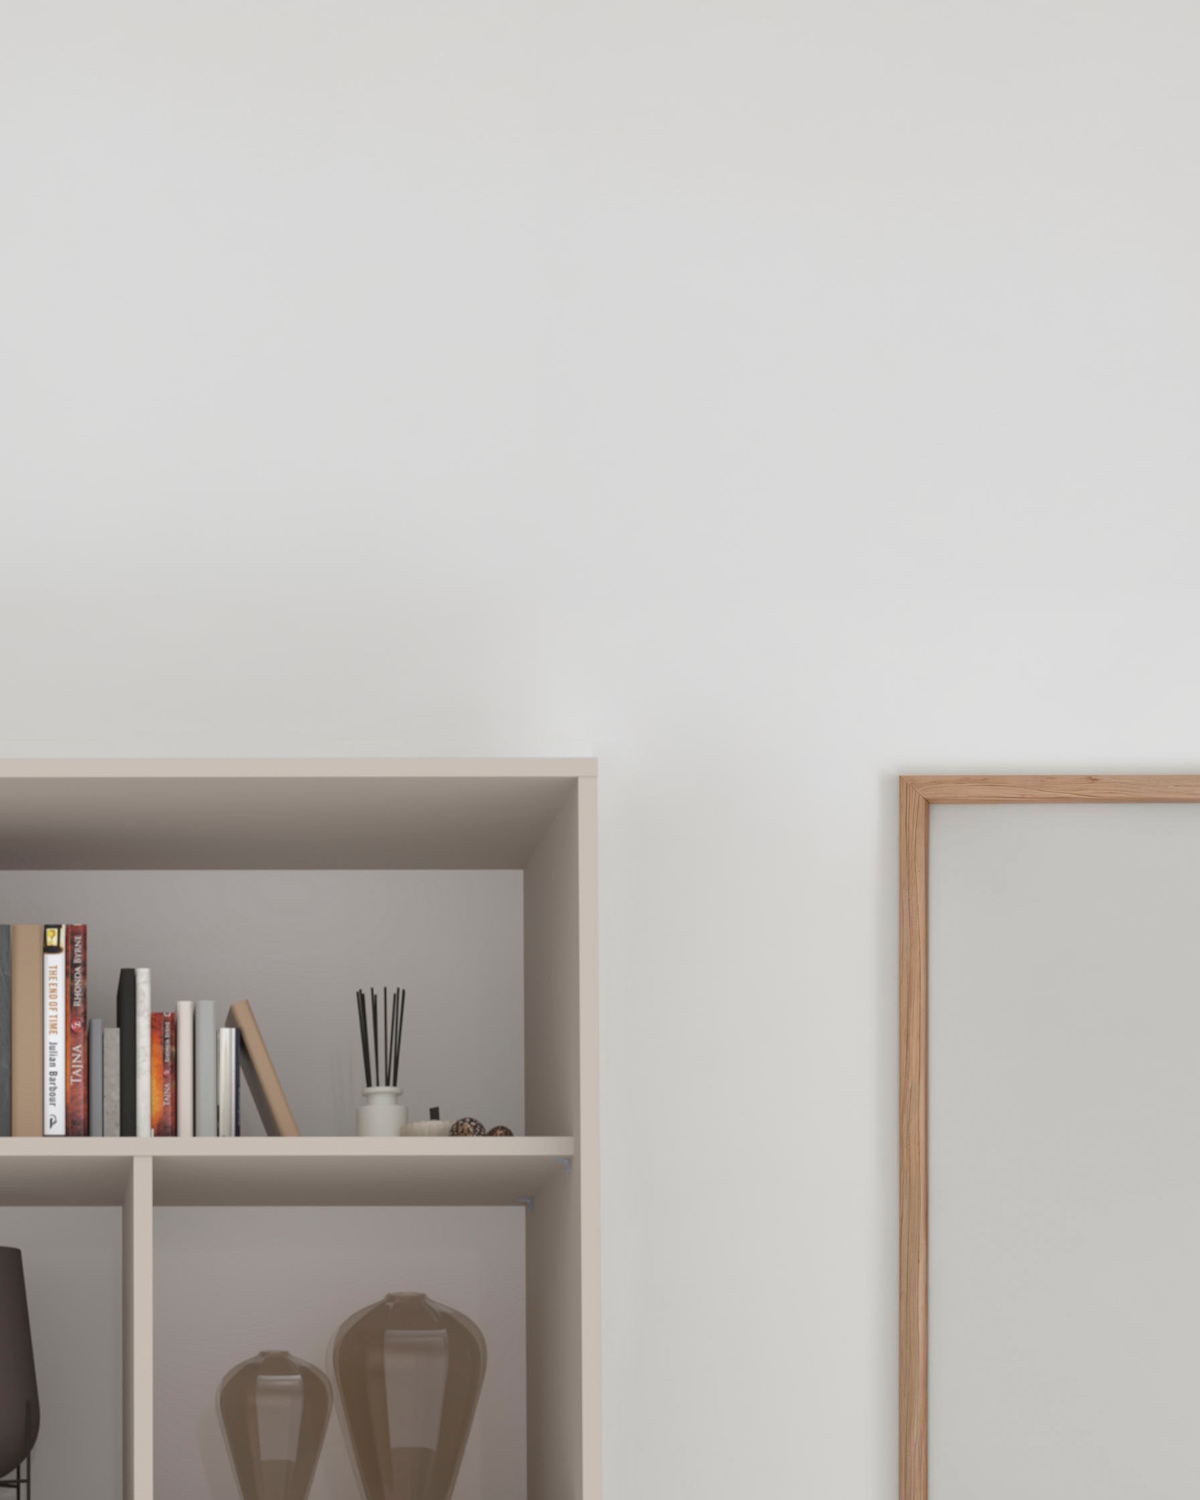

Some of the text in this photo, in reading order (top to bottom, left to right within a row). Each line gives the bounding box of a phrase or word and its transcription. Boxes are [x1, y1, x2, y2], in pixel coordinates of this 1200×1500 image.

[49, 965, 58, 1035] THE END OF TIME
[72, 935, 83, 1008] RHONDA BYRNE
[49, 1041, 58, 1107] Julian Barbour
[70, 1044, 84, 1086] TAJNA
